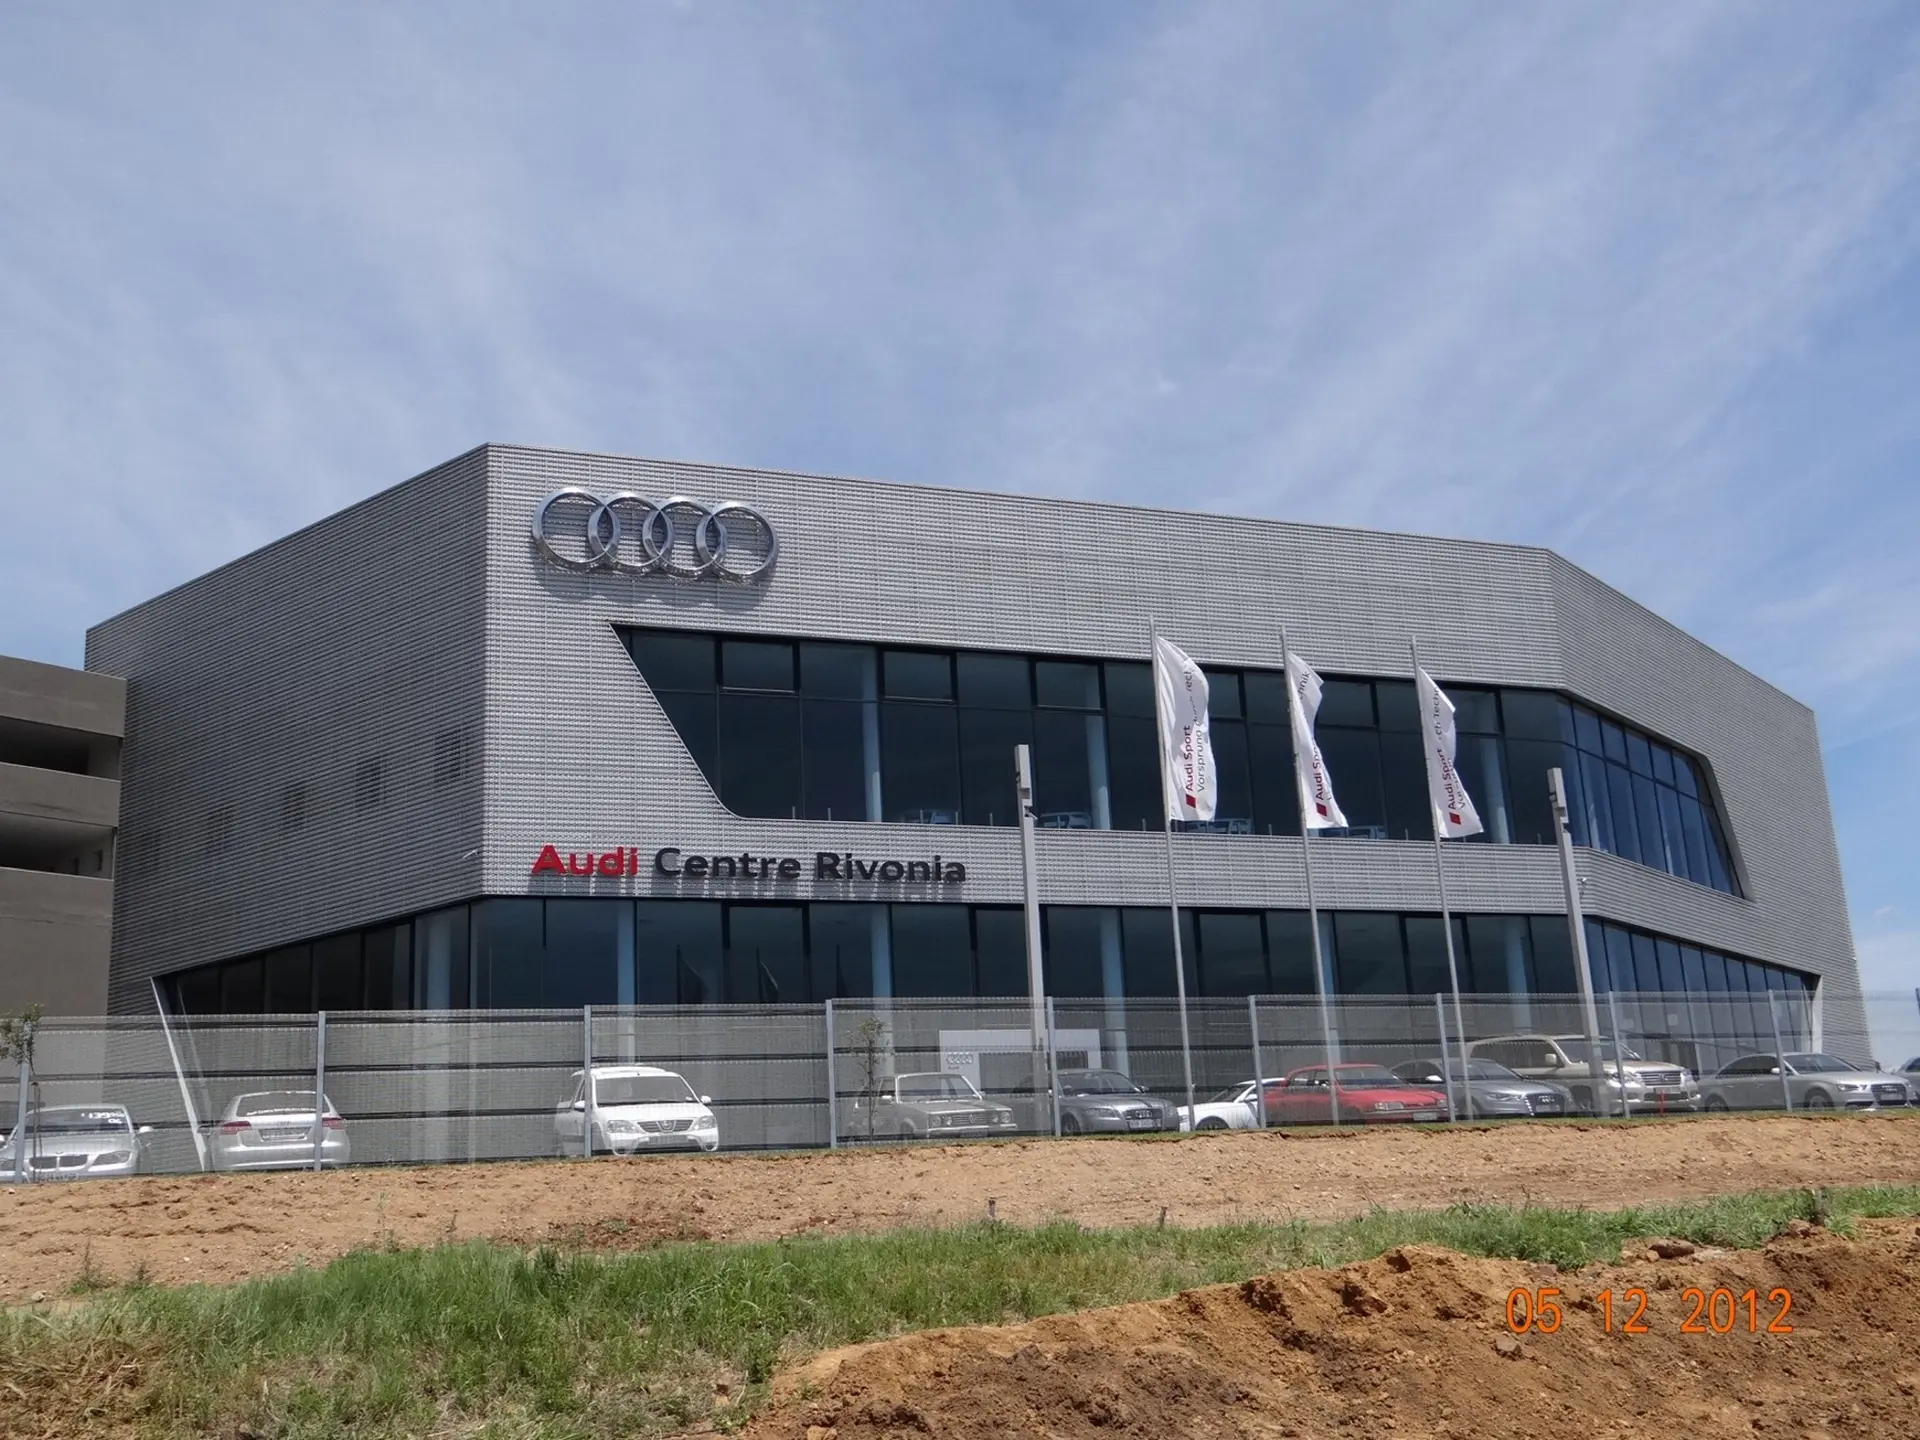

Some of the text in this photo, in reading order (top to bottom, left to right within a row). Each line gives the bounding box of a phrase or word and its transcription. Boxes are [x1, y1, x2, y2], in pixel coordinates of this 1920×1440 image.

[1183, 725, 1194, 792] Audi Sport
[1314, 772, 1324, 801] Audi
[1444, 783, 1457, 810] Audi
[531, 845, 967, 883] Audi Centre Rivonia
